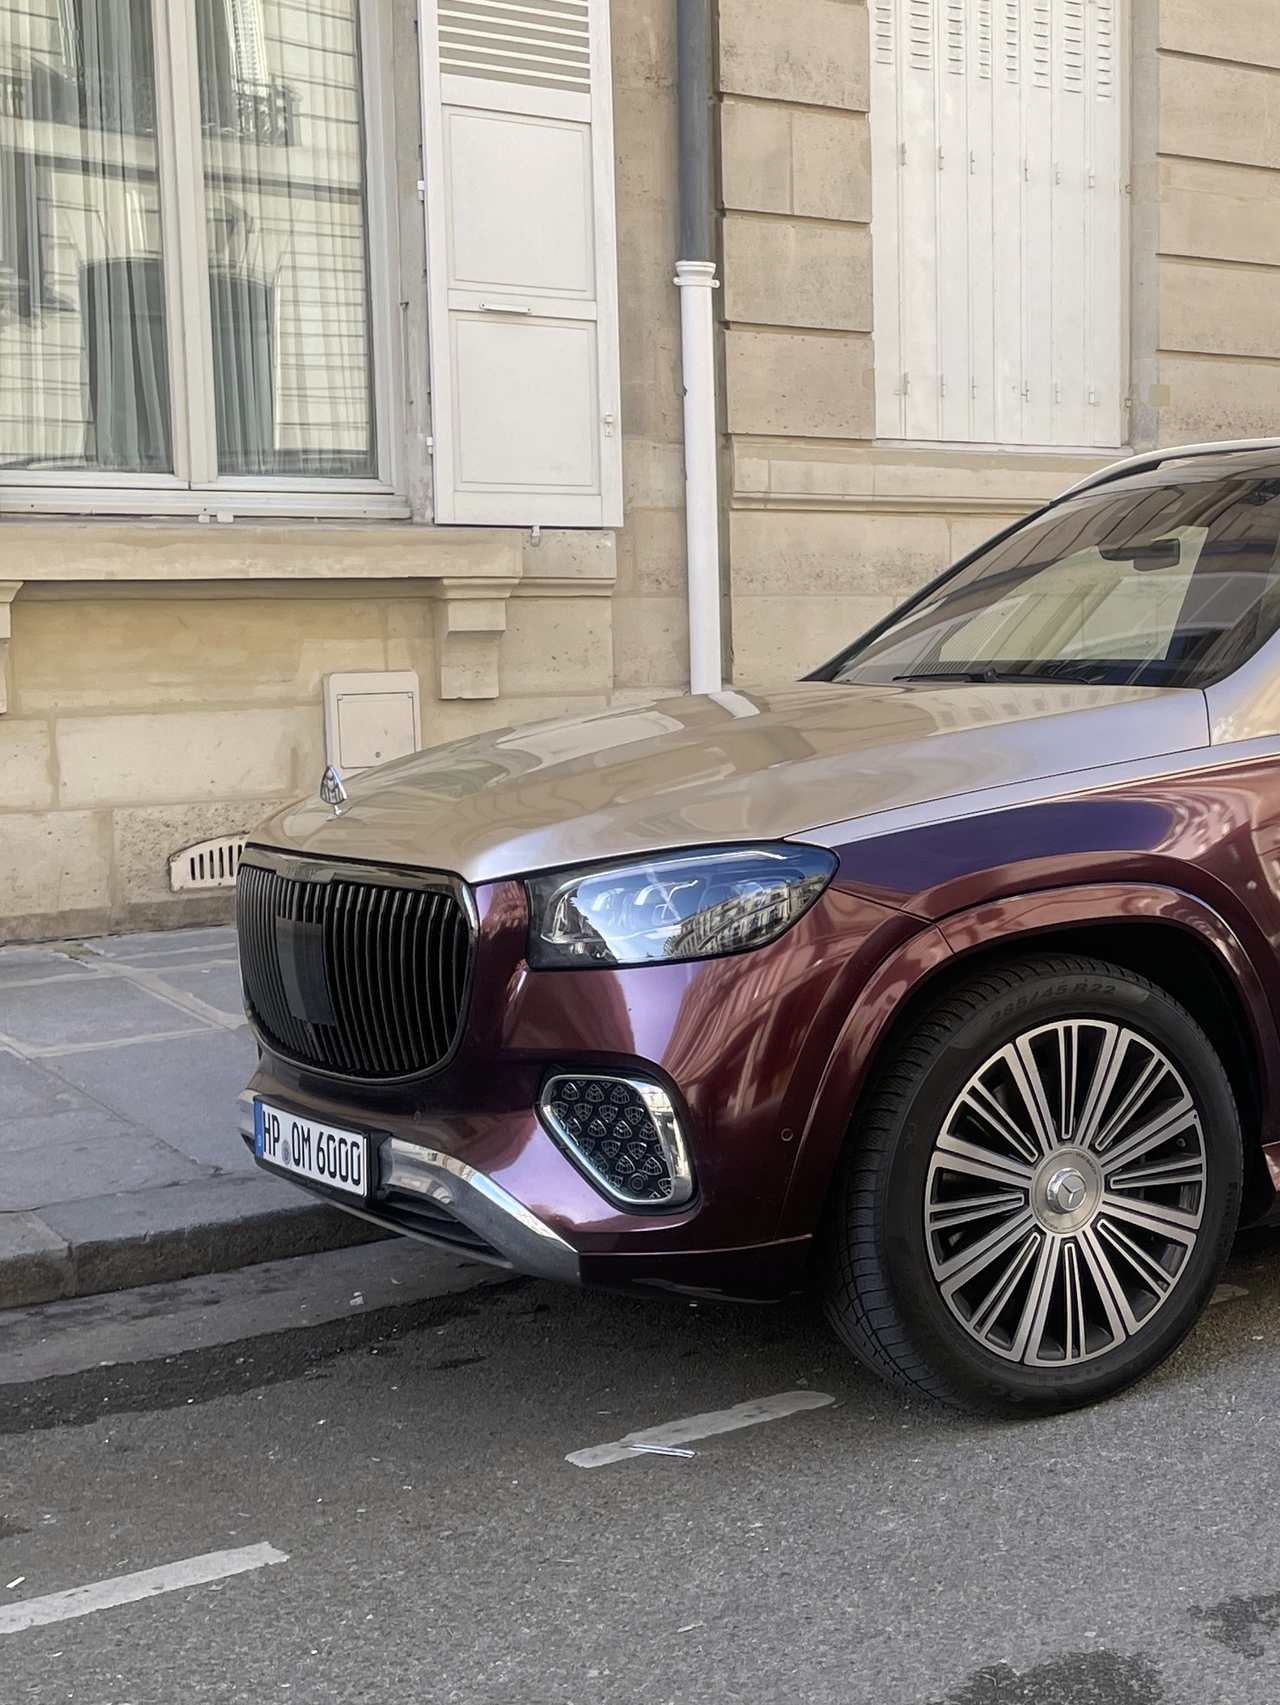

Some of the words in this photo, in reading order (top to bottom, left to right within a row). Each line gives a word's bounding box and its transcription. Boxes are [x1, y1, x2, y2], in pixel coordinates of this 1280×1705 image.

[263, 1110, 281, 1157] HP
[291, 1121, 312, 1172] OM
[316, 1131, 361, 1187] 6000
